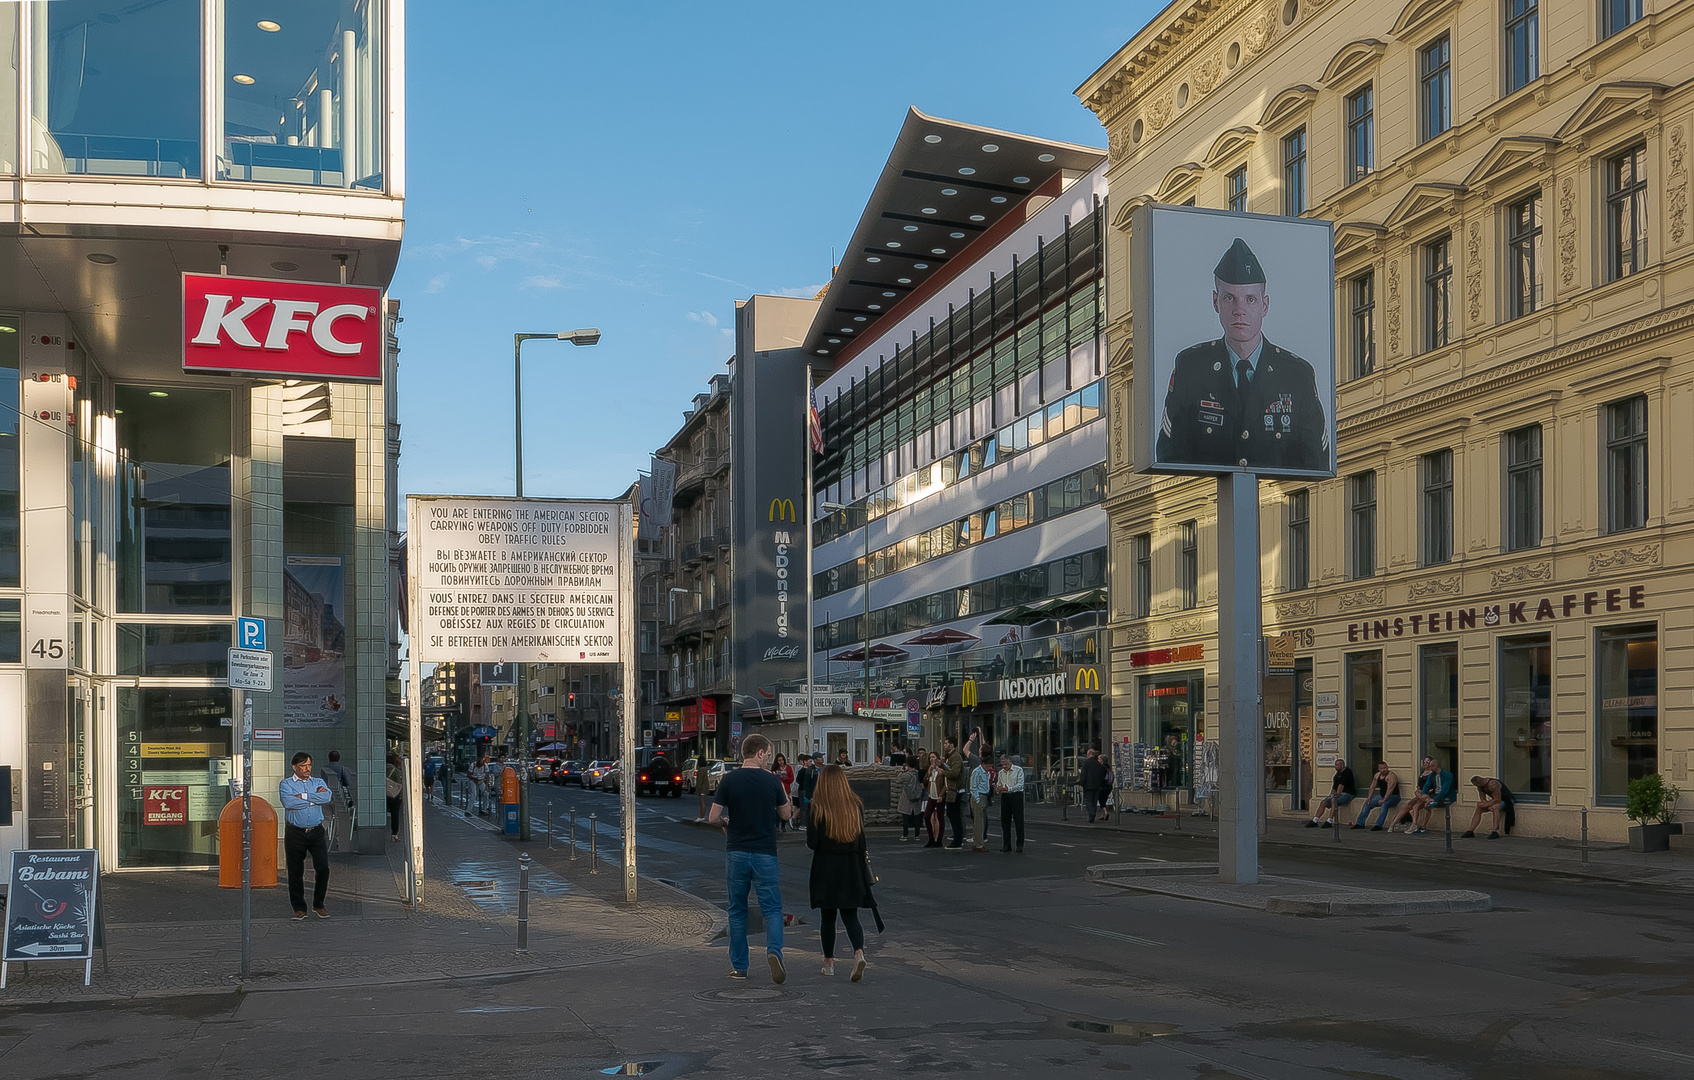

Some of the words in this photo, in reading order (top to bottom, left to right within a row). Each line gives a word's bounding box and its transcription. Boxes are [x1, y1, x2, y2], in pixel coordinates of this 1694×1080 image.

[191, 293, 369, 355] KFC
[50, 336, 62, 346] UG
[51, 373, 61, 383] UG
[51, 411, 61, 420] UG
[431, 508, 450, 519] YOU
[453, 508, 468, 519] ARE
[473, 509, 512, 520] ENTERING
[515, 509, 529, 520] THE
[534, 510, 575, 521] AMERICAN
[579, 511, 609, 521] SECTOR
[430, 521, 474, 531] CARRYING
[477, 522, 518, 532] WEAPONS
[522, 522, 537, 532] OFF
[541, 523, 561, 533] DUTY
[565, 523, 609, 534] FORBIDDEN
[479, 534, 500, 544] OBEY
[505, 535, 538, 544] TRAFFIC
[542, 536, 566, 545] RULES
[437, 550, 450, 560] ВЫ
[501, 551, 507, 561] В
[511, 551, 576, 562] АМЕРИКАНСКИЙ
[579, 553, 607, 563] СЕКТОР
[429, 563, 457, 573] НОСИТЬ
[459, 563, 487, 573] ОРУЖИЕ
[534, 564, 539, 573] В
[592, 566, 614, 575] ВРЕМЯ
[504, 576, 553, 586] ДОРОЖНЫМ
[558, 577, 601, 587] ПРАВИЛАМ
[430, 593, 453, 603] VOUS
[458, 594, 487, 603] ENTREZ
[492, 594, 514, 604] DANS
[519, 594, 526, 603] LE
[531, 594, 565, 604] SECTEUR
[429, 606, 459, 616] DEFENSE
[460, 606, 470, 616] DE
[471, 607, 496, 616] PORTER
[498, 607, 510, 616] DES
[512, 607, 534, 616] ARMES
[536, 607, 546, 616] EN
[548, 607, 574, 616] DEHORS
[577, 607, 586, 616] DU
[588, 608, 614, 617] SERVICE
[1348, 607, 1477, 643] EINSTEIN
[1509, 584, 1646, 623] KAFFEE
[440, 617, 481, 629] OBÉISSEZ
[486, 619, 503, 629] AUX
[507, 620, 536, 629] REGLES
[541, 620, 550, 629] DE
[555, 619, 605, 629] CIRCULATION
[244, 621, 259, 646] P
[431, 636, 443, 647] SIE
[448, 636, 488, 647] BETRETEN
[492, 636, 508, 647] DEN
[511, 636, 580, 647] AMERIKANISCHEN
[584, 636, 613, 647] SEKTOR
[31, 639, 64, 659] 45
[784, 698, 793, 707] US
[795, 698, 808, 707] ARM
[1264, 711, 1290, 729] OVERS
[129, 731, 137, 741] 5
[129, 745, 138, 755] 4
[130, 760, 138, 770] 3
[130, 774, 138, 784] 2
[148, 789, 184, 800] KFC
[28, 854, 81, 863] Restaurant
[18, 866, 90, 882] Babami
[53, 923, 76, 931] Küche
[48, 931, 69, 939] Sushi
